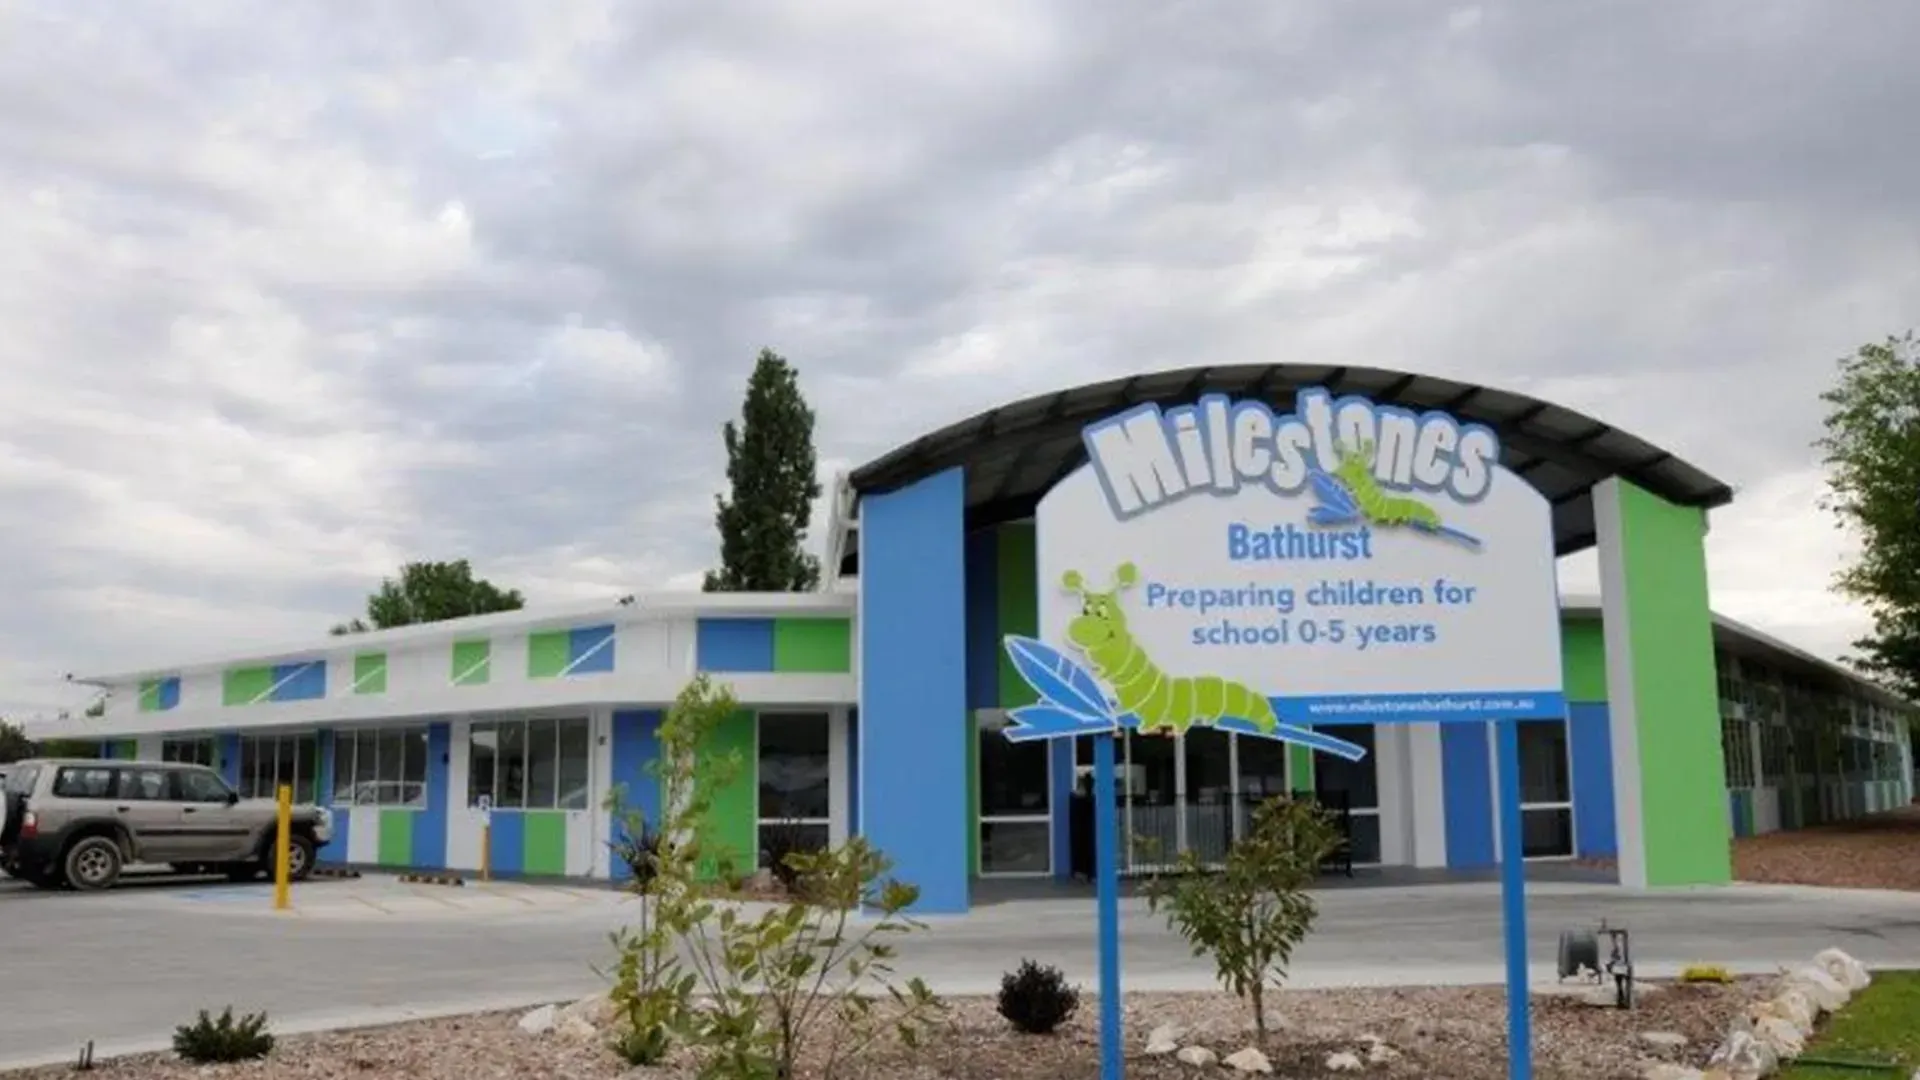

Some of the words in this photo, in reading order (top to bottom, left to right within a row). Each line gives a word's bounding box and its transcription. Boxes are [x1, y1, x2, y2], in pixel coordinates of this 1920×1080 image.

[1227, 523, 1372, 560] Bathurst
[1146, 582, 1295, 614] Preparing
[1306, 579, 1424, 607] children
[1434, 578, 1477, 605] for
[1192, 619, 1289, 646] school
[1298, 619, 1345, 644] 0-5
[1356, 621, 1437, 651] years
[1309, 698, 1535, 714] www.milestonesbathurst.com.au
